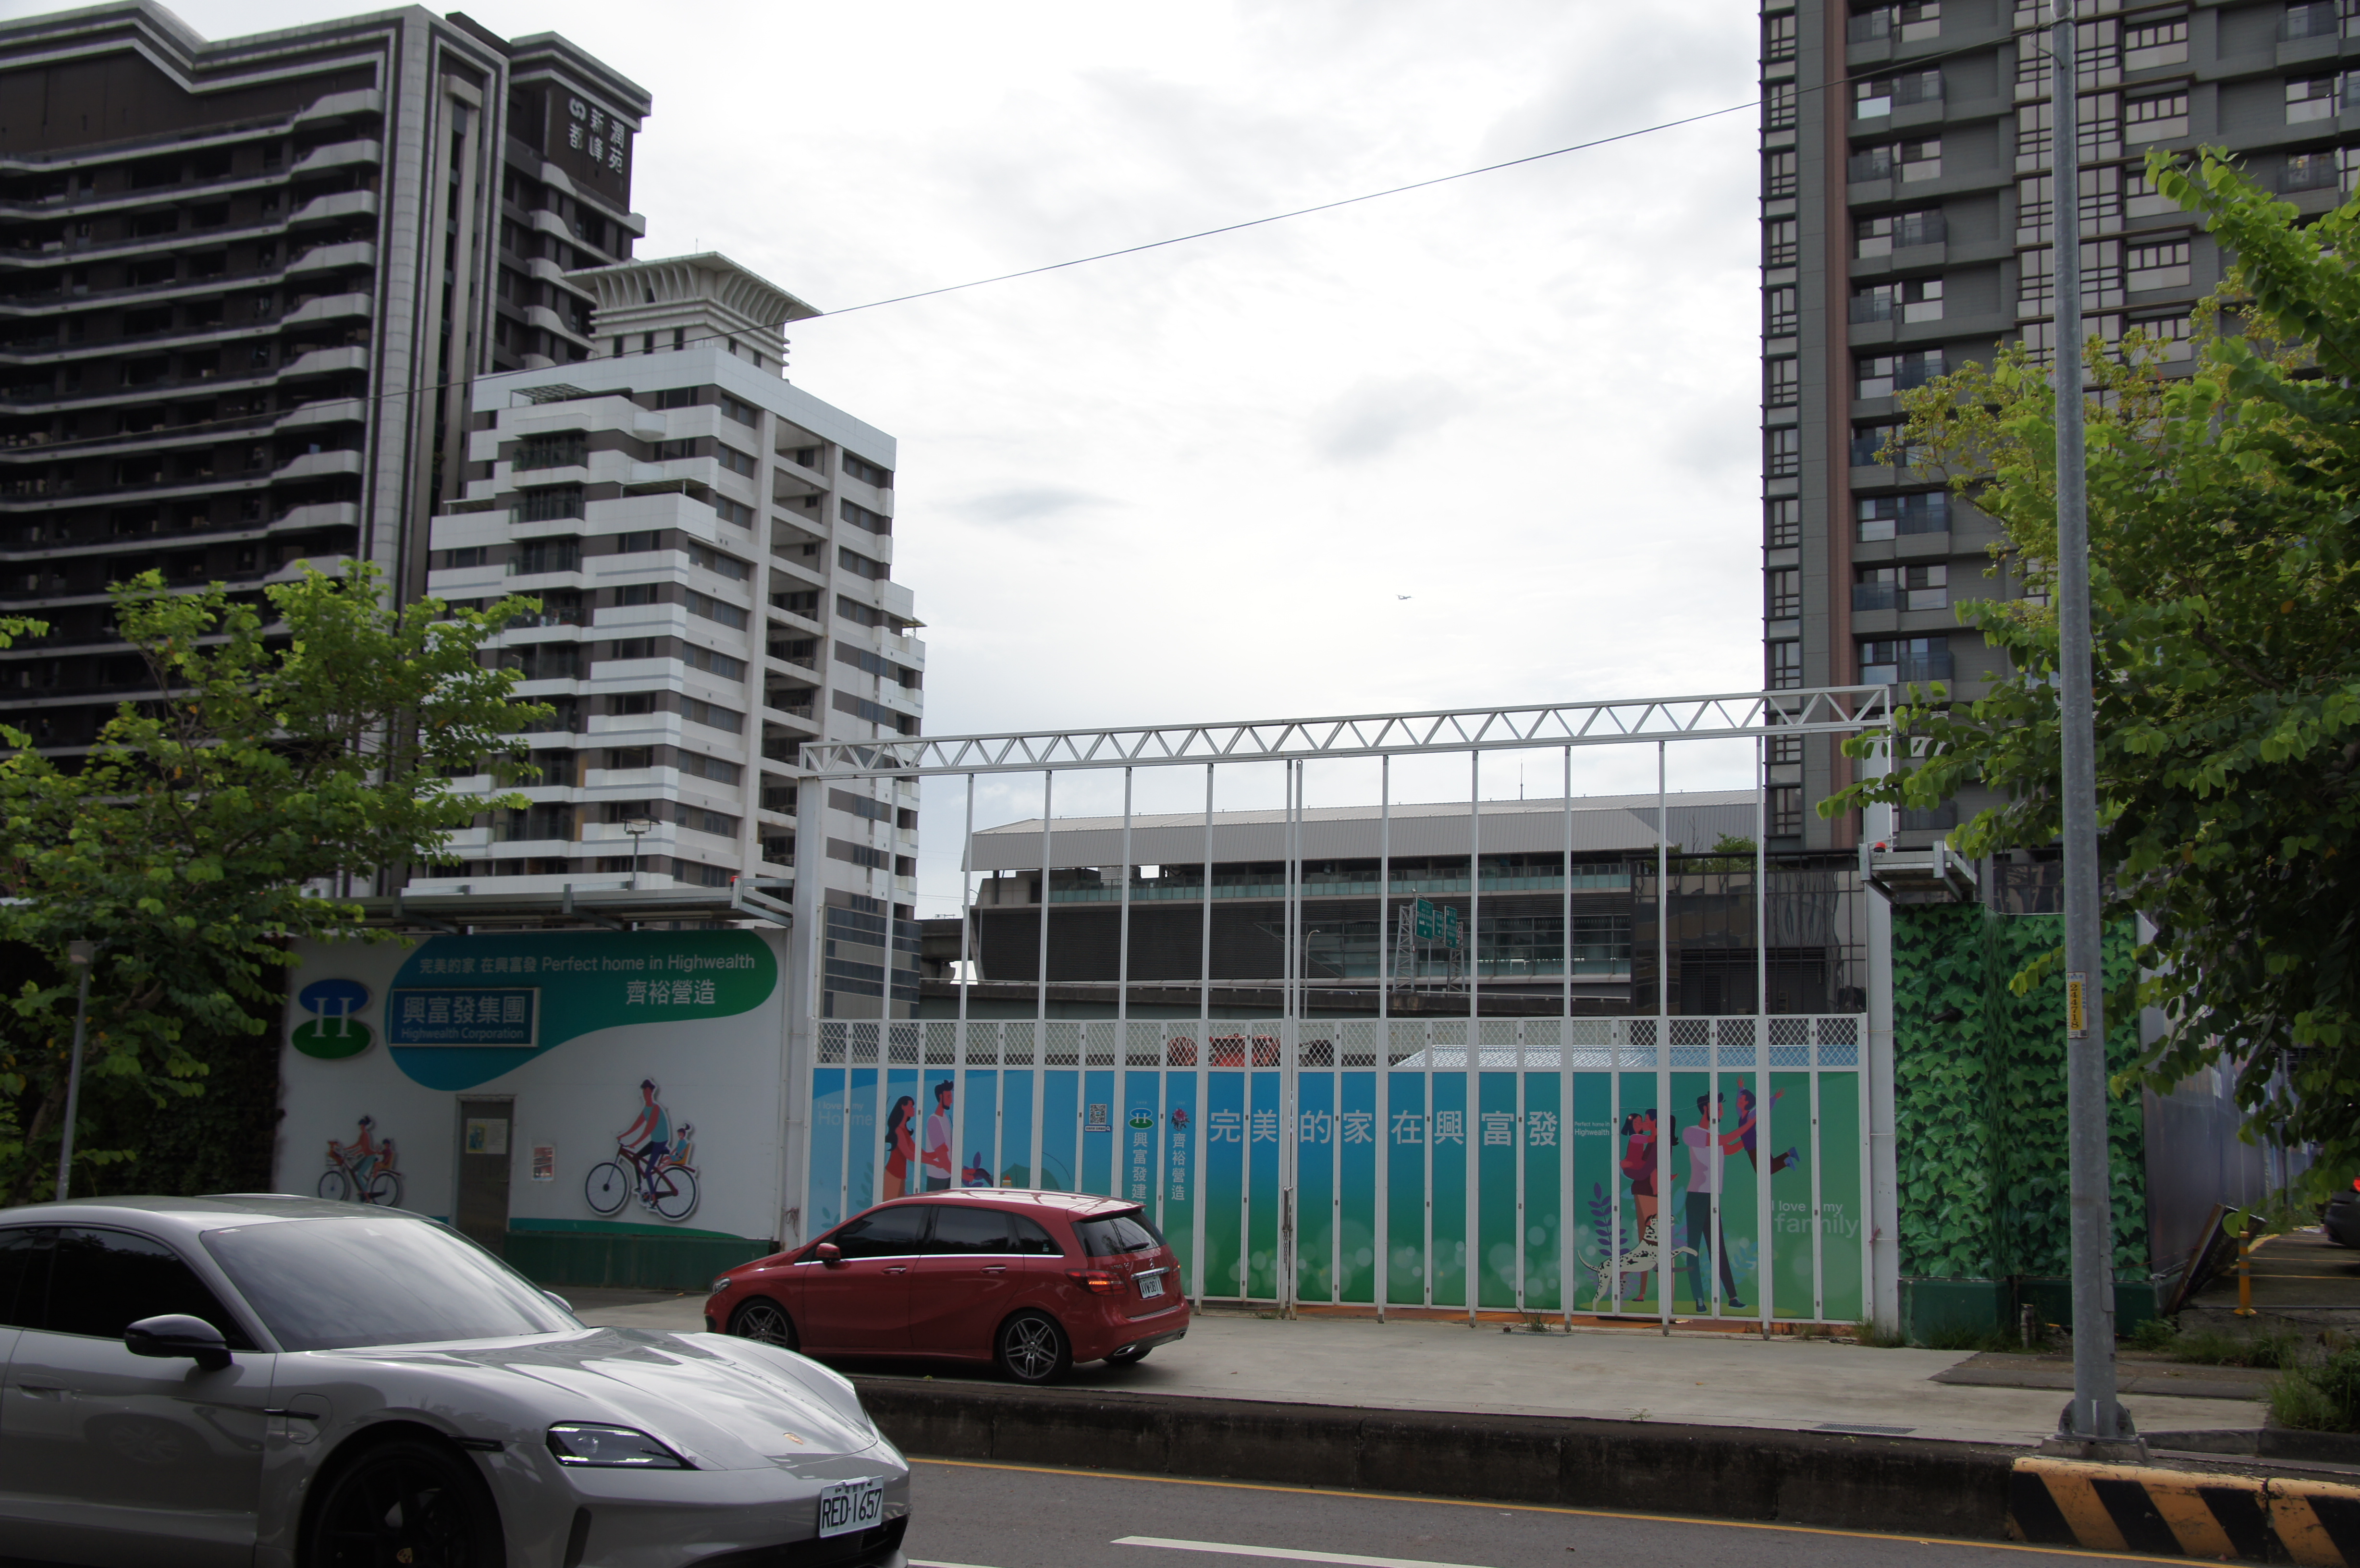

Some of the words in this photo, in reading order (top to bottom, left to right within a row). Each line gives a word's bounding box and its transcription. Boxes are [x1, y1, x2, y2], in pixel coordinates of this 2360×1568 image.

[420, 958, 476, 974] 完美的家
[481, 956, 537, 973] 在興富發
[543, 956, 598, 971] Perfect
[602, 956, 644, 971] home
[650, 955, 662, 970] in
[668, 954, 755, 973] Highwealth
[626, 979, 716, 1004] 齊裕營造
[403, 996, 526, 1024] 興富發集團
[2070, 984, 2078, 1028] 244718
[401, 1027, 459, 1041] Highwealth
[461, 1027, 524, 1041] Corporation
[824, 1101, 842, 1110] love
[852, 1103, 864, 1111] my
[818, 1111, 873, 1126] Home
[1574, 1128, 1610, 1137] Highwealth
[1131, 1132, 1148, 1205] 興富發建
[1171, 1133, 1186, 1200] 齊裕營造
[1779, 1200, 1806, 1212] love
[1823, 1203, 1843, 1214] my
